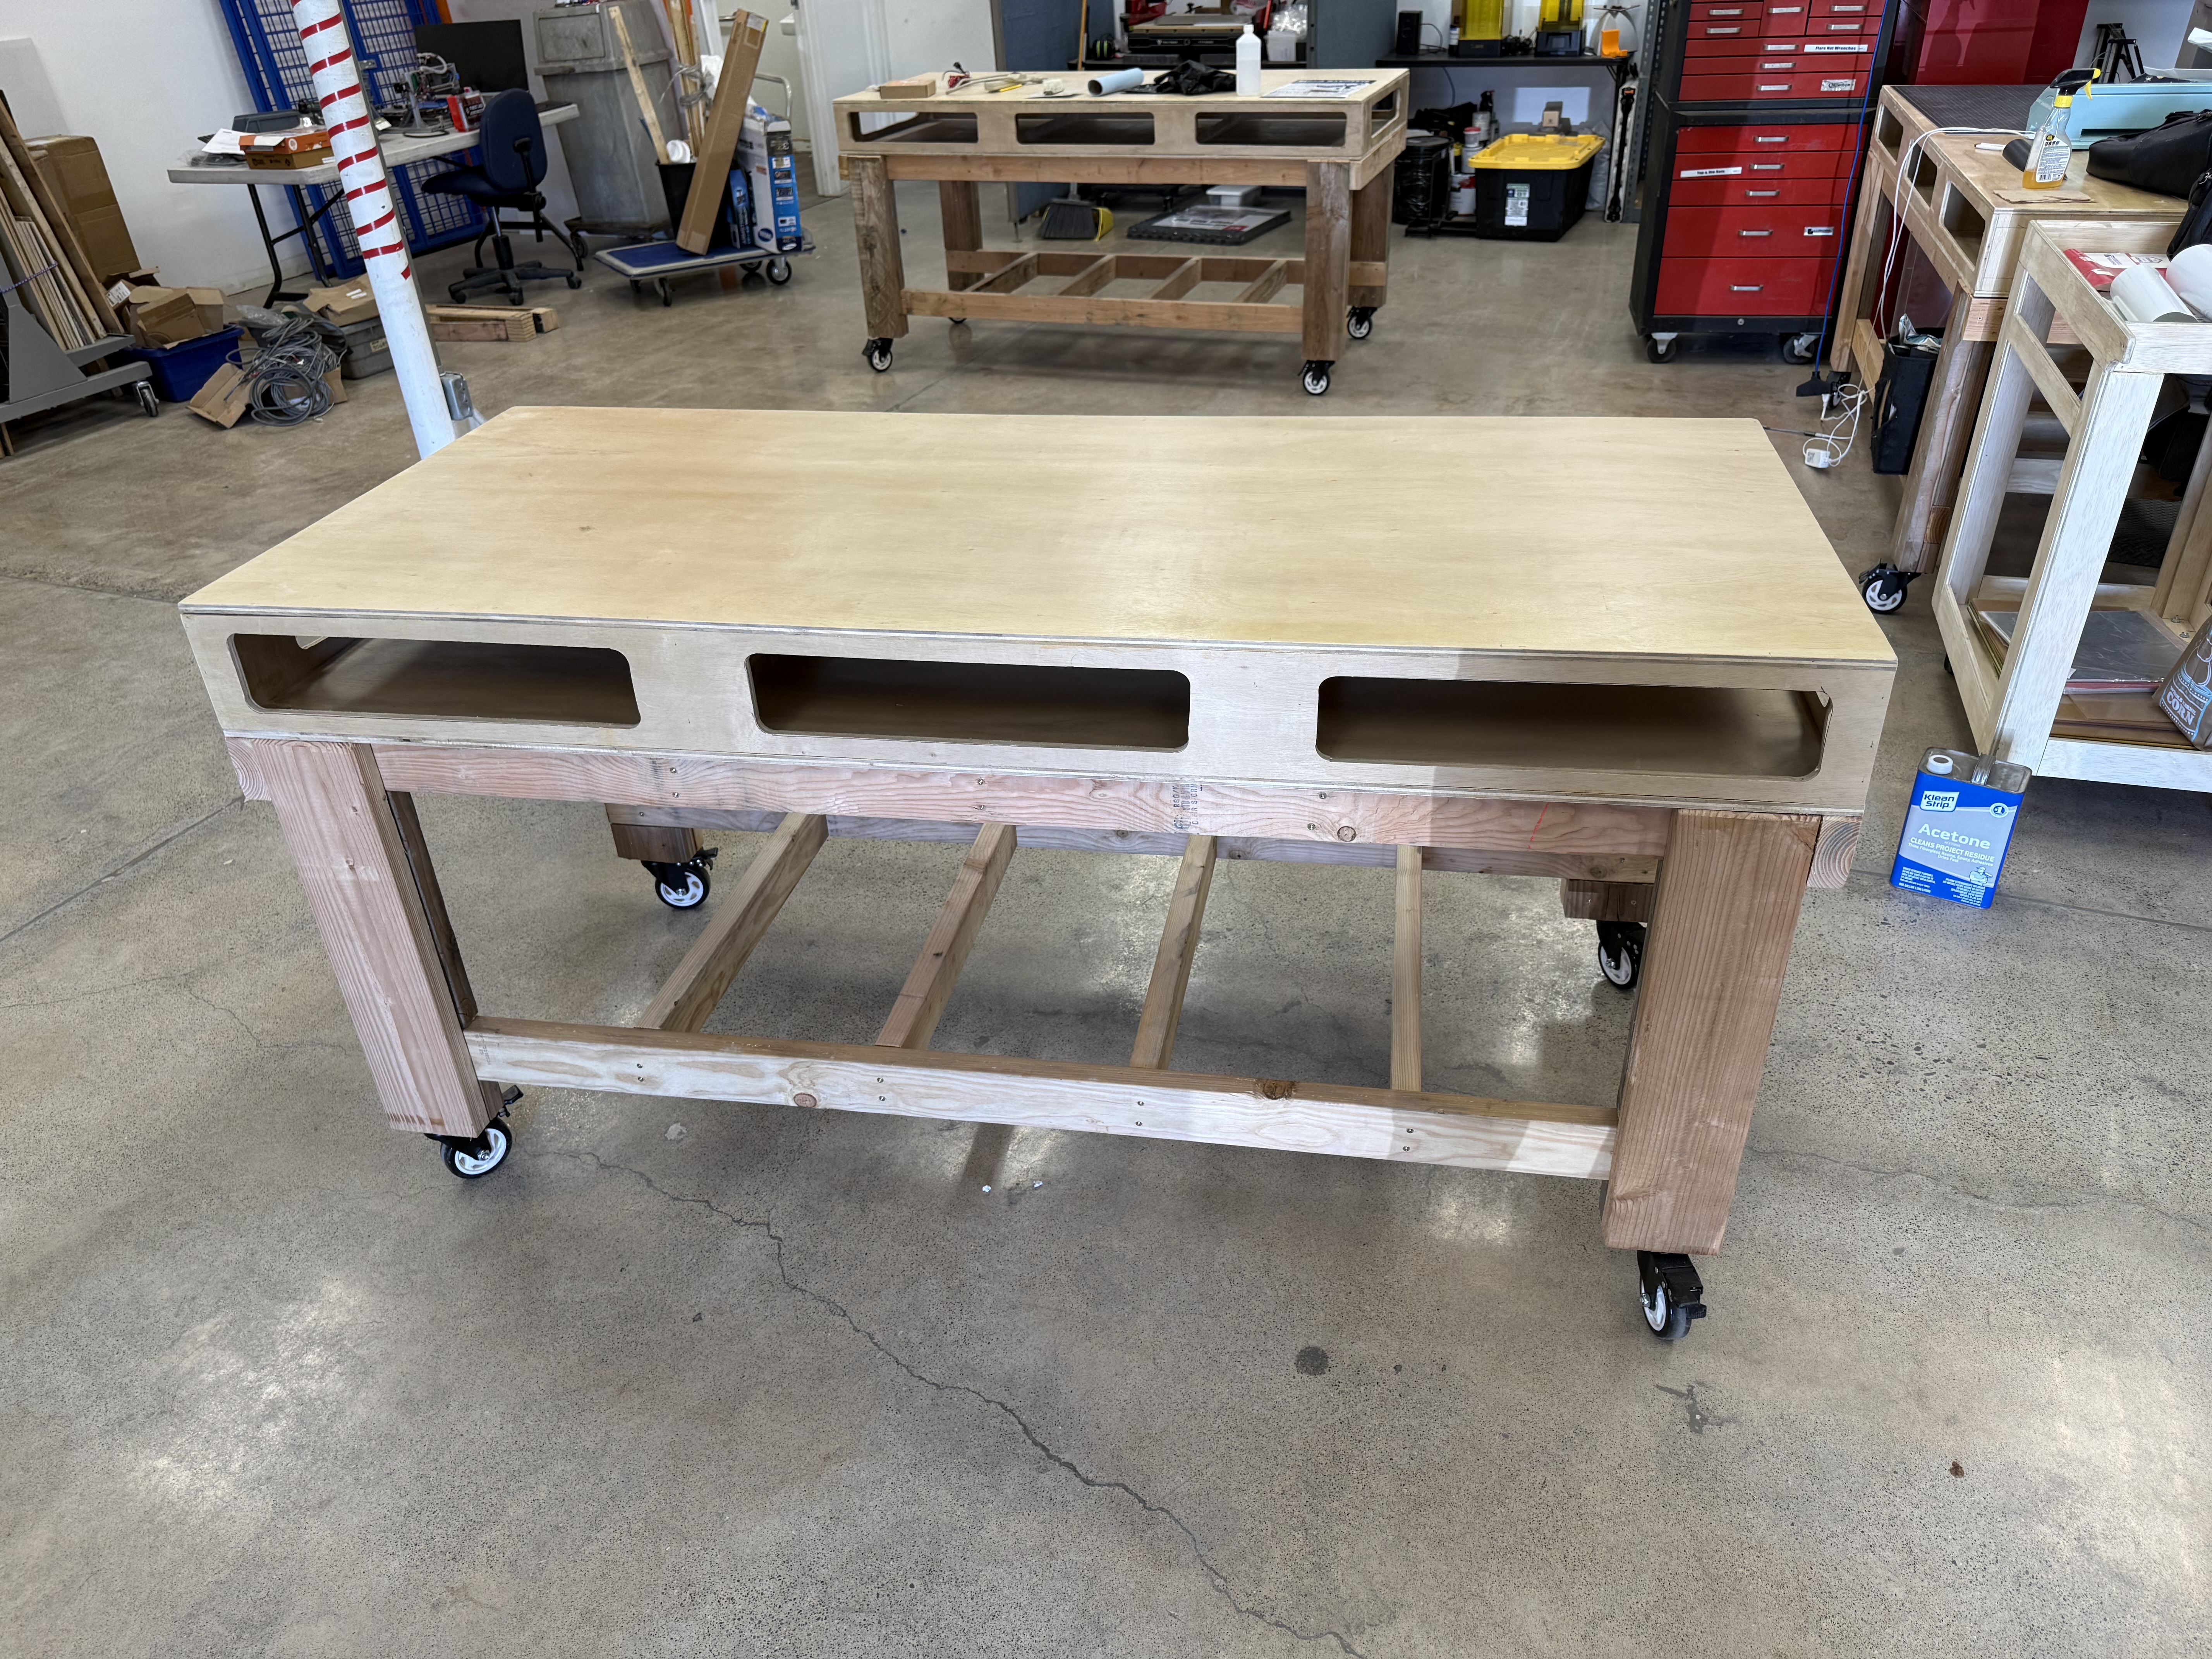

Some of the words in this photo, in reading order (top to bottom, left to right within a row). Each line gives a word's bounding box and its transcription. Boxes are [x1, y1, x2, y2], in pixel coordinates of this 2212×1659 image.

[2167, 691, 2195, 725] CORN
[1925, 801, 1949, 809] Strip
[1918, 823, 1990, 849] Acetone
[1910, 837, 1935, 848] CLEANS
[1936, 843, 1965, 855] PROJECT
[1964, 850, 1995, 862] RESIDUE
[1919, 846, 1941, 855] Fiberglass
[1971, 859, 1994, 867] Adhesives
